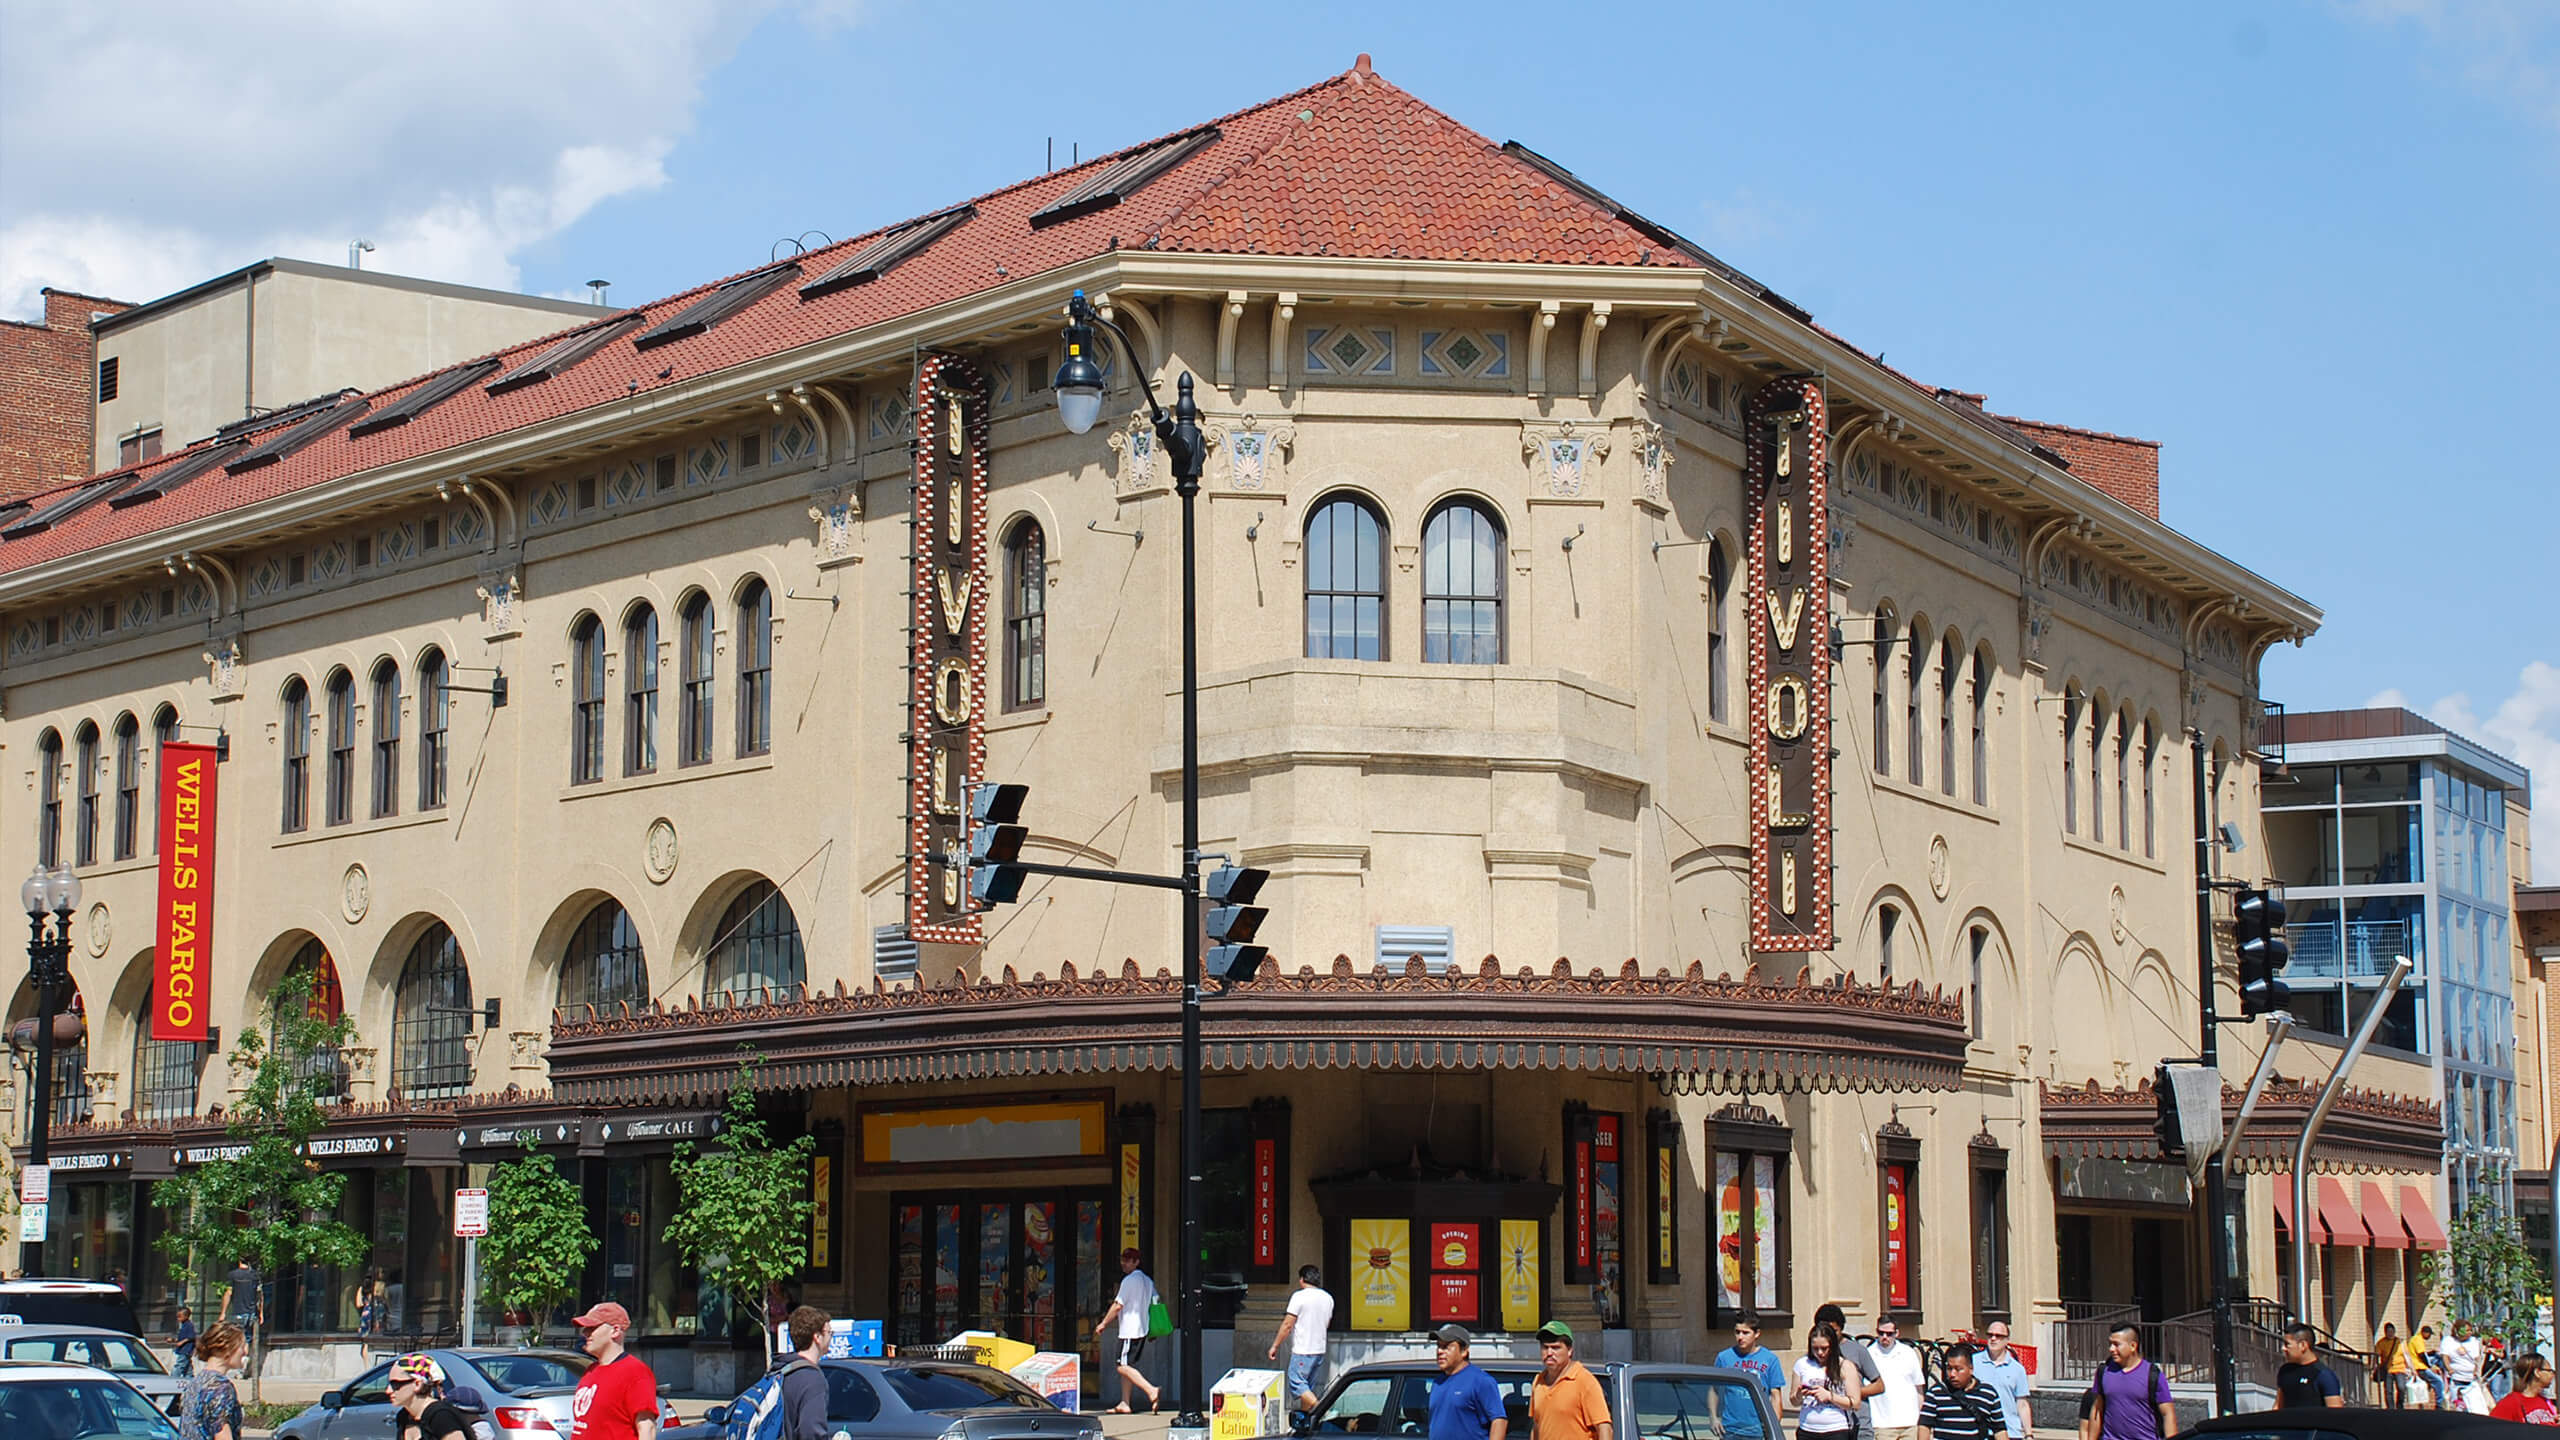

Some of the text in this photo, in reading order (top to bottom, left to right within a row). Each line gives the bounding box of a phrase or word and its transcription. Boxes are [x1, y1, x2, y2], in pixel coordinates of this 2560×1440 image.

[933, 387, 976, 907] TIVOLI
[1764, 408, 1811, 916] TIVOLI
[167, 758, 202, 1028] WELLS FARGO
[664, 1120, 695, 1135] CAFE
[187, 1147, 220, 1162] WELLS
[308, 1138, 380, 1156] WELLS FARGO
[48, 1154, 109, 1170] WELLS FARGO
[1221, 1421, 1255, 1436] Latino
